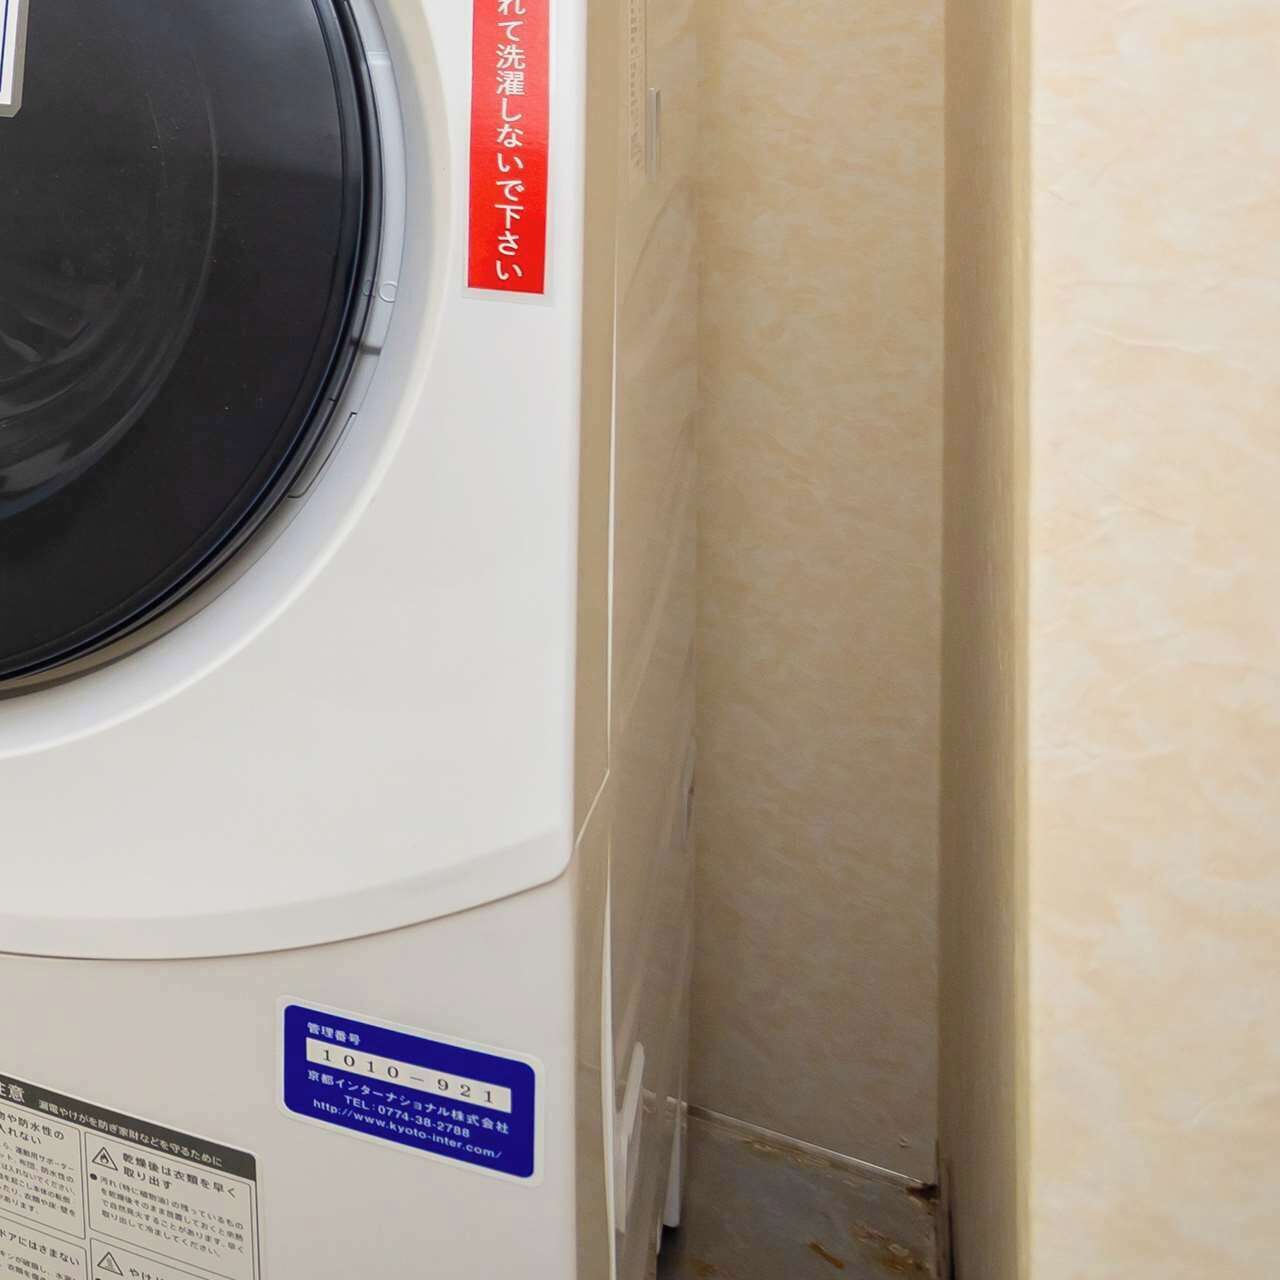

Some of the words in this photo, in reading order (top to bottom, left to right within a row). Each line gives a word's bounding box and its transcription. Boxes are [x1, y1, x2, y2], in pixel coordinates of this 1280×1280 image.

[306, 1022, 361, 1046] 管理番号
[307, 1069, 509, 1135] 京都インターナショナル株式会社
[313, 1097, 503, 1159] http://www.kyoto-inter.com/
[122, 1152, 237, 1199] 乾燥後は衣類を早く
[123, 1166, 173, 1191] 取り出す
